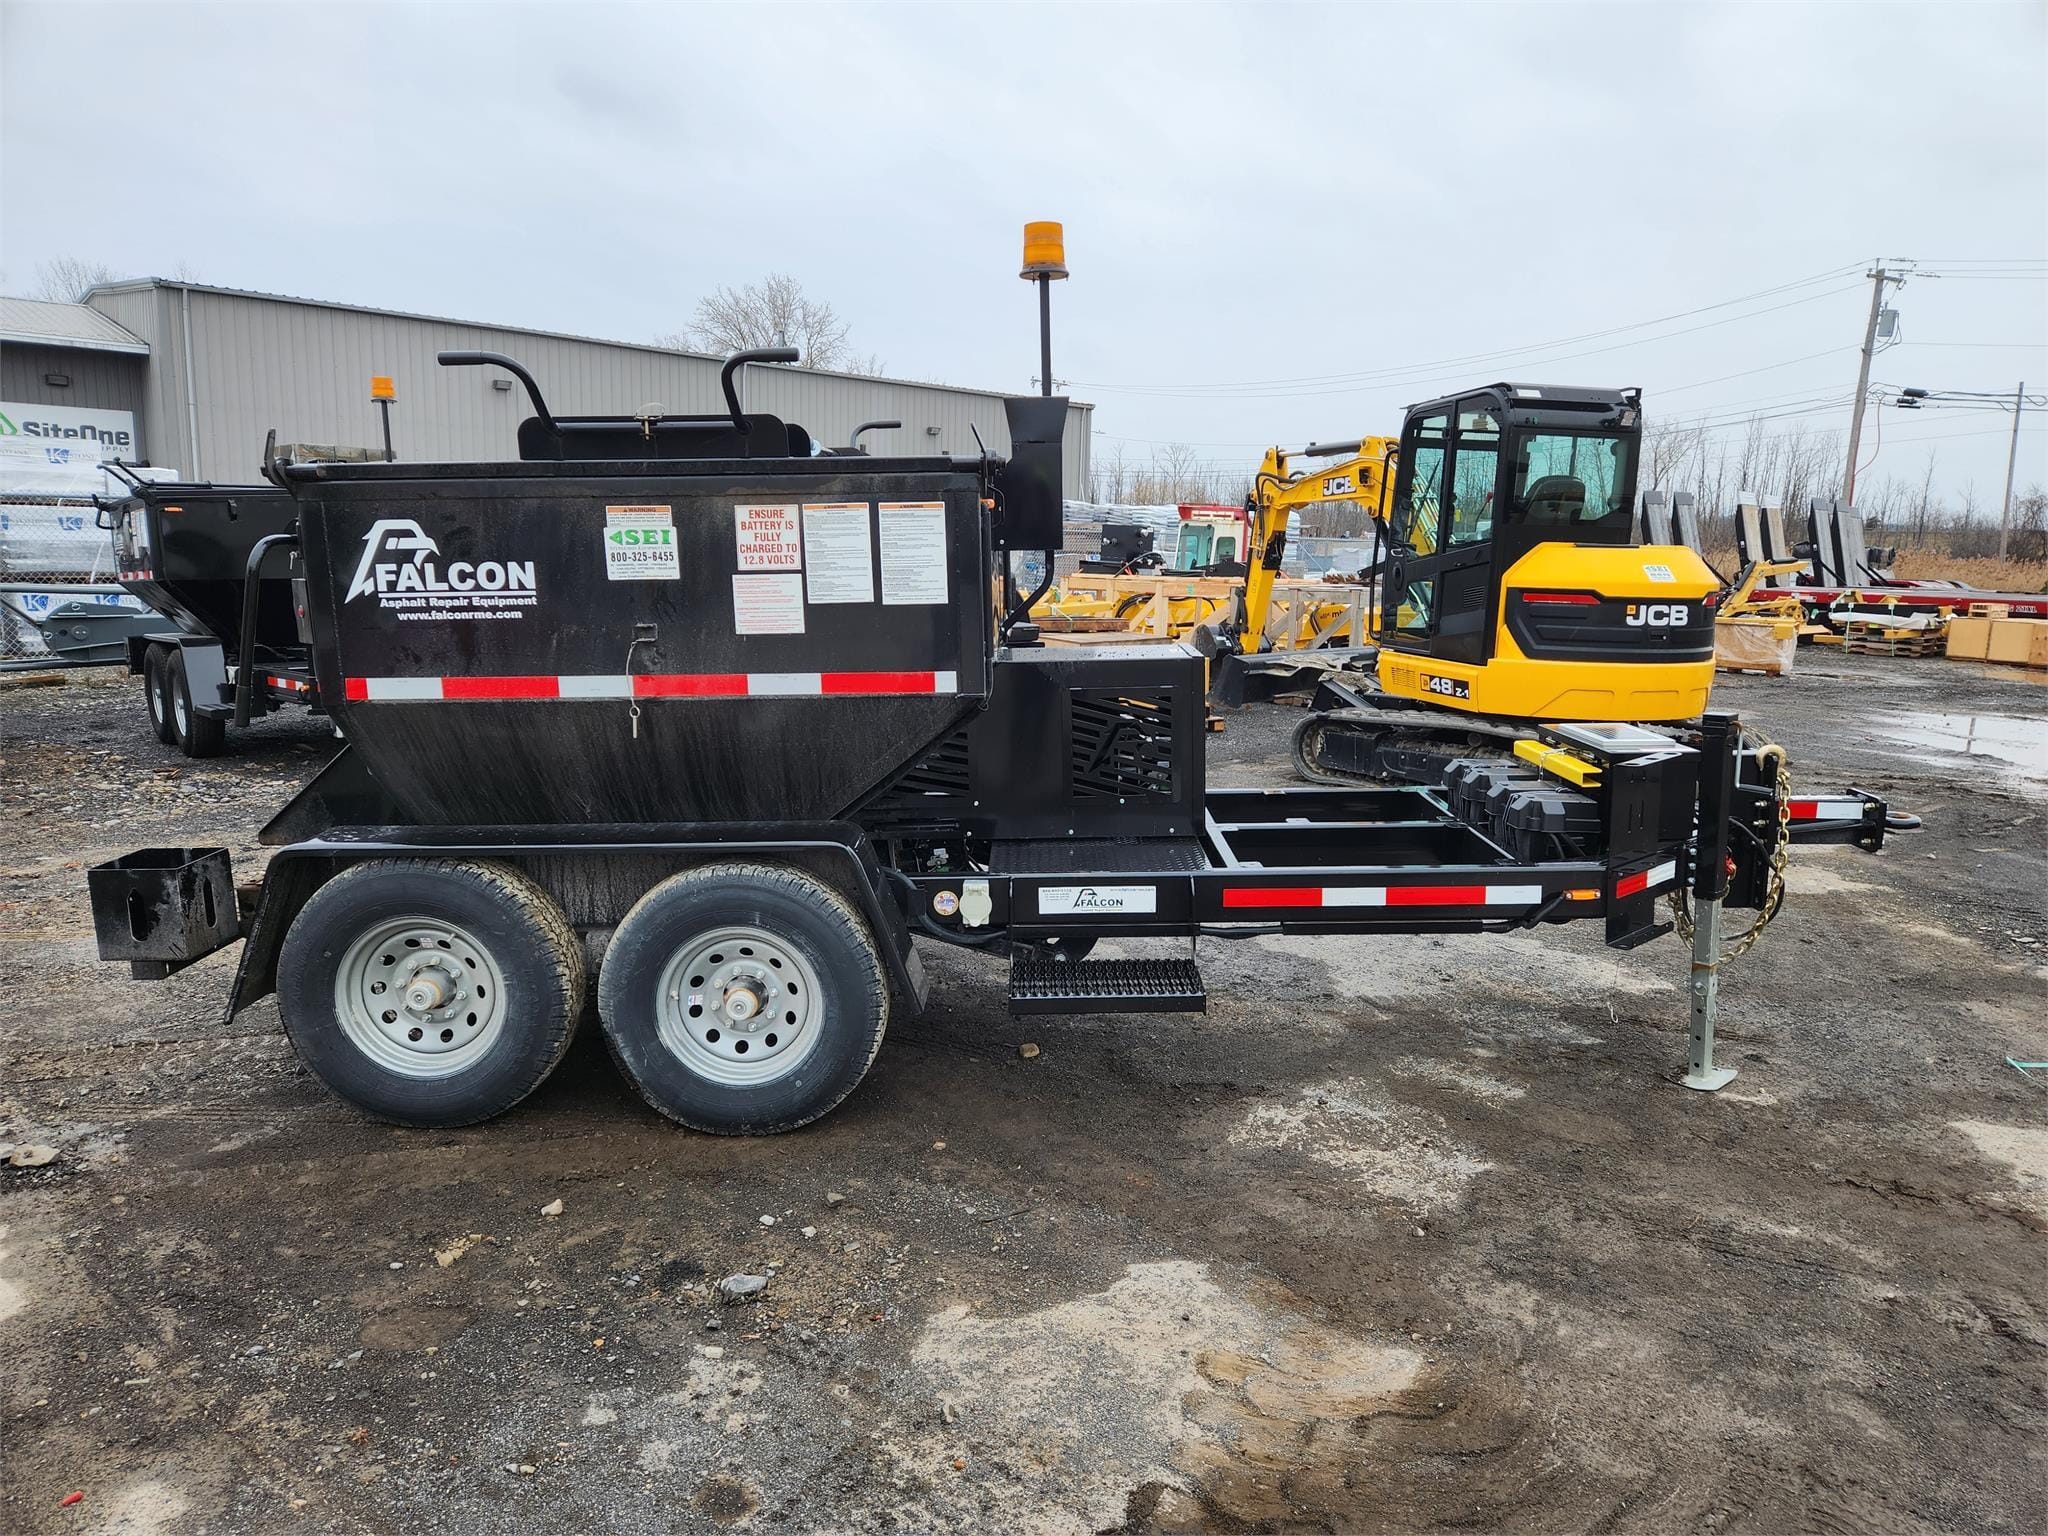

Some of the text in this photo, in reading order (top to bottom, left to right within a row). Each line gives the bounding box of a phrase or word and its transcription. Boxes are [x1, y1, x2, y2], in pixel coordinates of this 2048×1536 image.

[22, 421, 130, 446] SiteOne
[748, 509, 785, 519] ENSURE
[741, 520, 794, 531] BATTERY IS
[624, 529, 672, 545] SEI
[754, 532, 781, 541] FULLY
[740, 543, 798, 553] CHARGED TO
[610, 552, 674, 562] 800-325-6455
[744, 555, 795, 565] 12.8 VOLTS
[375, 561, 537, 591] FALCON
[380, 596, 537, 608] Asphalt Repair Equipment
[397, 610, 523, 620] www.falconrme.com
[1626, 605, 1689, 626] JCB
[1430, 677, 1452, 695] 48
[1081, 899, 1124, 907] FALCON
